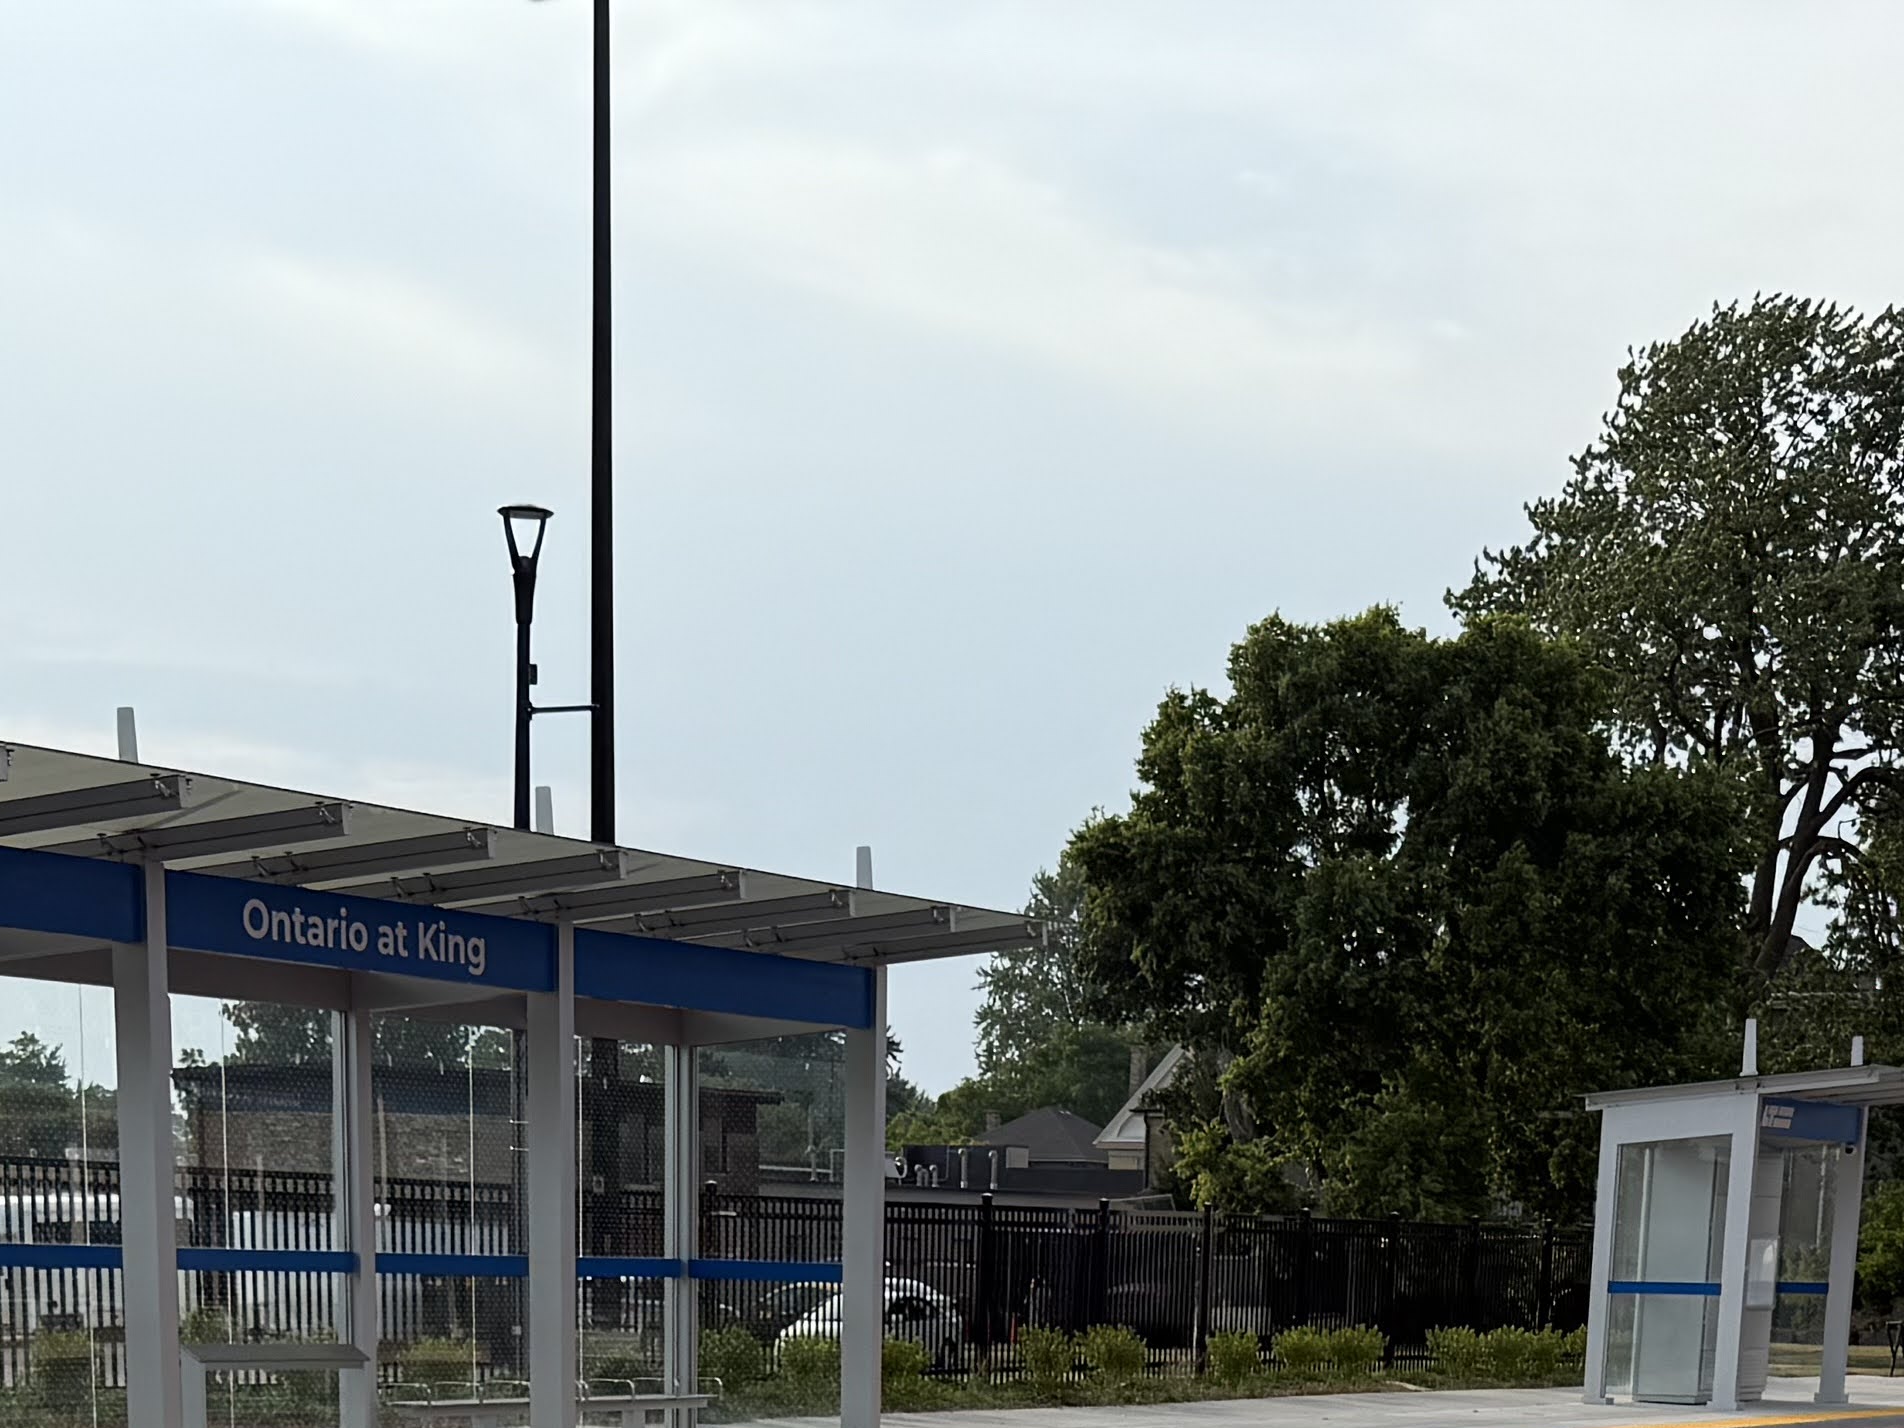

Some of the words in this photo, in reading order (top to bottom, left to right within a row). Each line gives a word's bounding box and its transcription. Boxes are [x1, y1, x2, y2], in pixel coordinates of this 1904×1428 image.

[242, 898, 369, 952] Ontario
[378, 922, 409, 958] at
[418, 921, 487, 976] King
